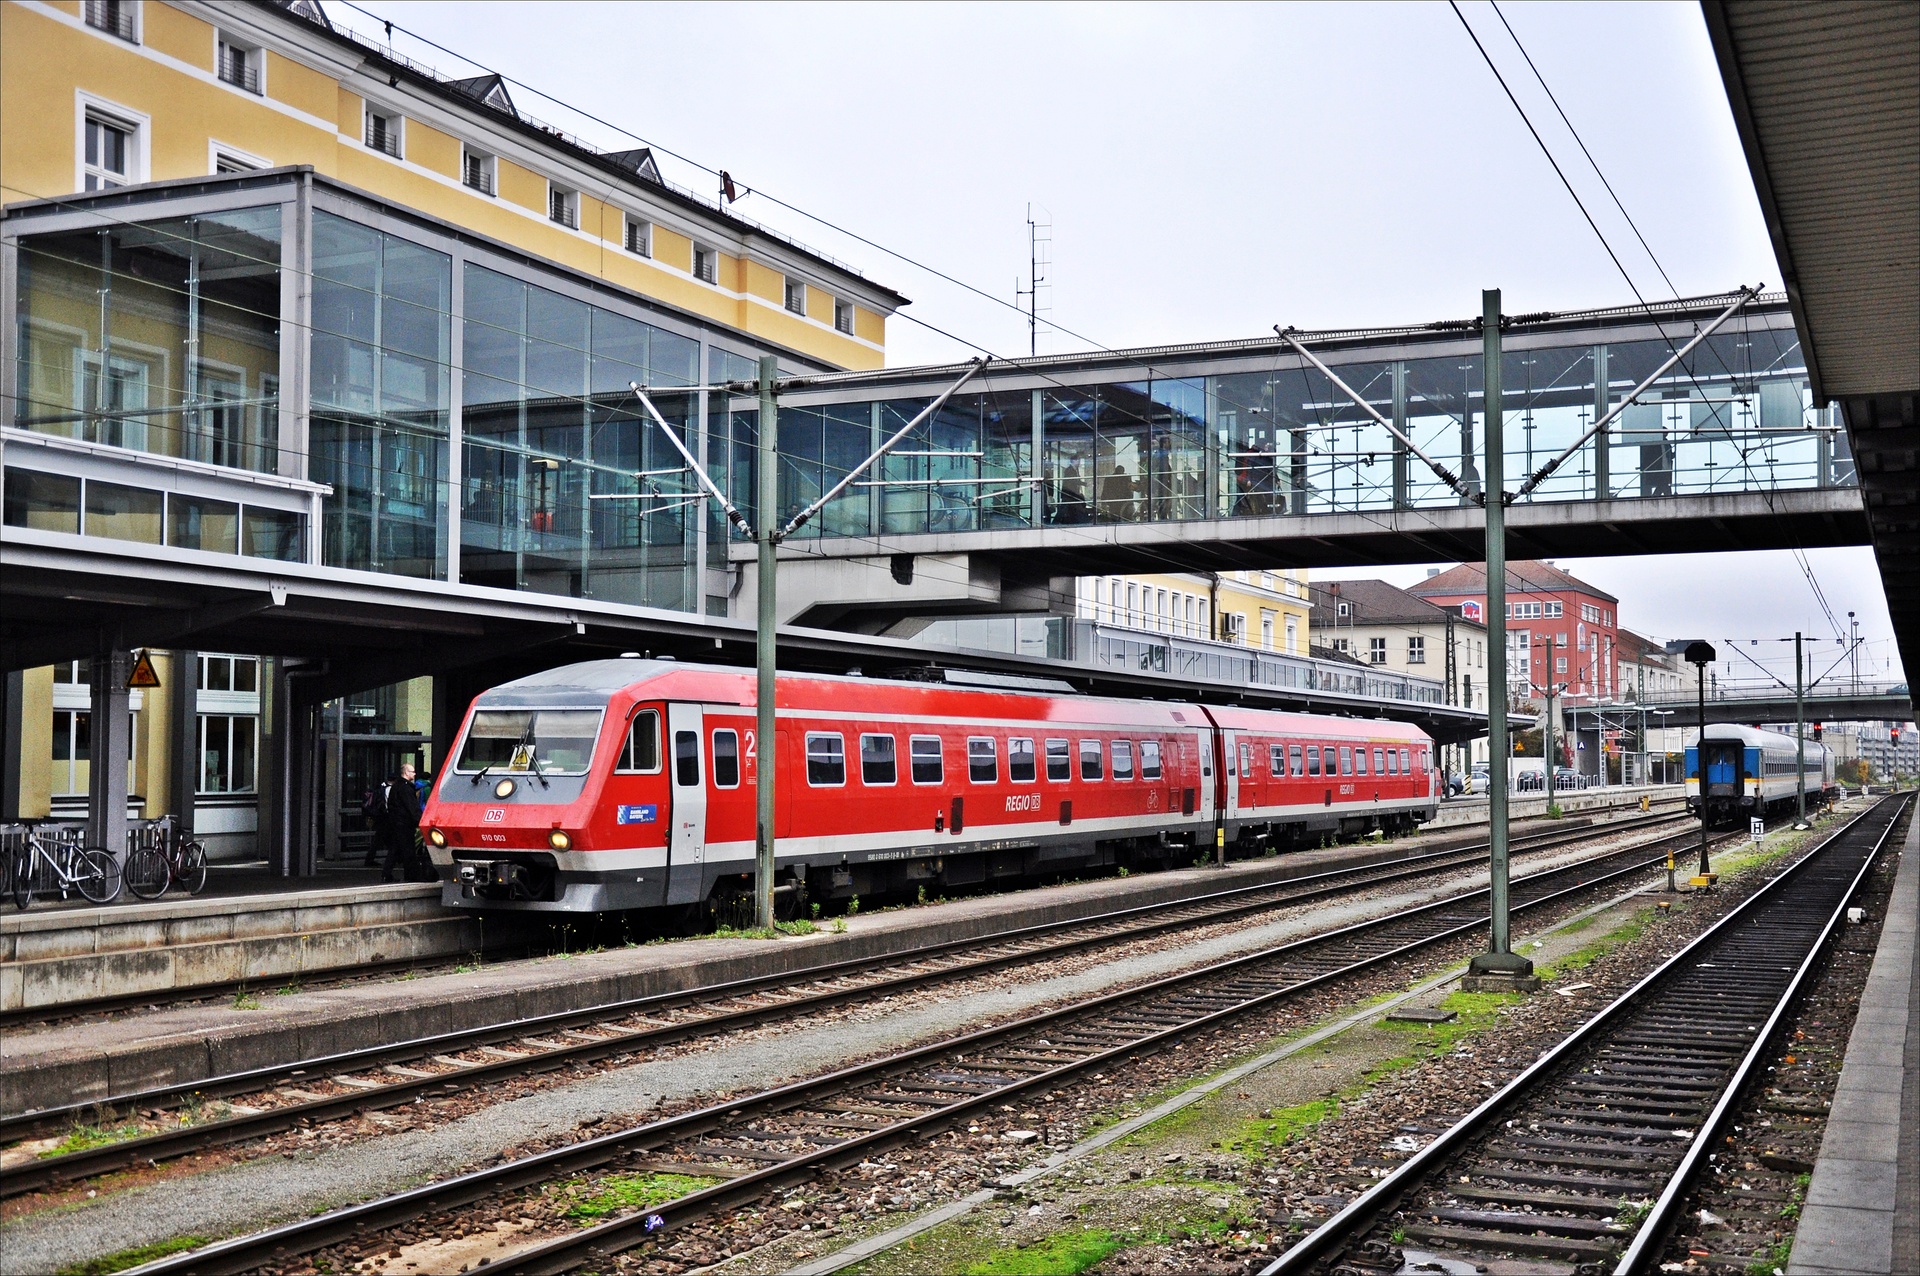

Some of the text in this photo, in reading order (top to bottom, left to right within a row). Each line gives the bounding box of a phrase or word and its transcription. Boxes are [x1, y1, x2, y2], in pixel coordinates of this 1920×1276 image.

[746, 731, 756, 756] 2
[1180, 744, 1186, 759] 2
[1250, 744, 1255, 759] 2
[1005, 795, 1030, 812] REGIO
[486, 810, 503, 821] DB
[1754, 824, 1761, 832] H
